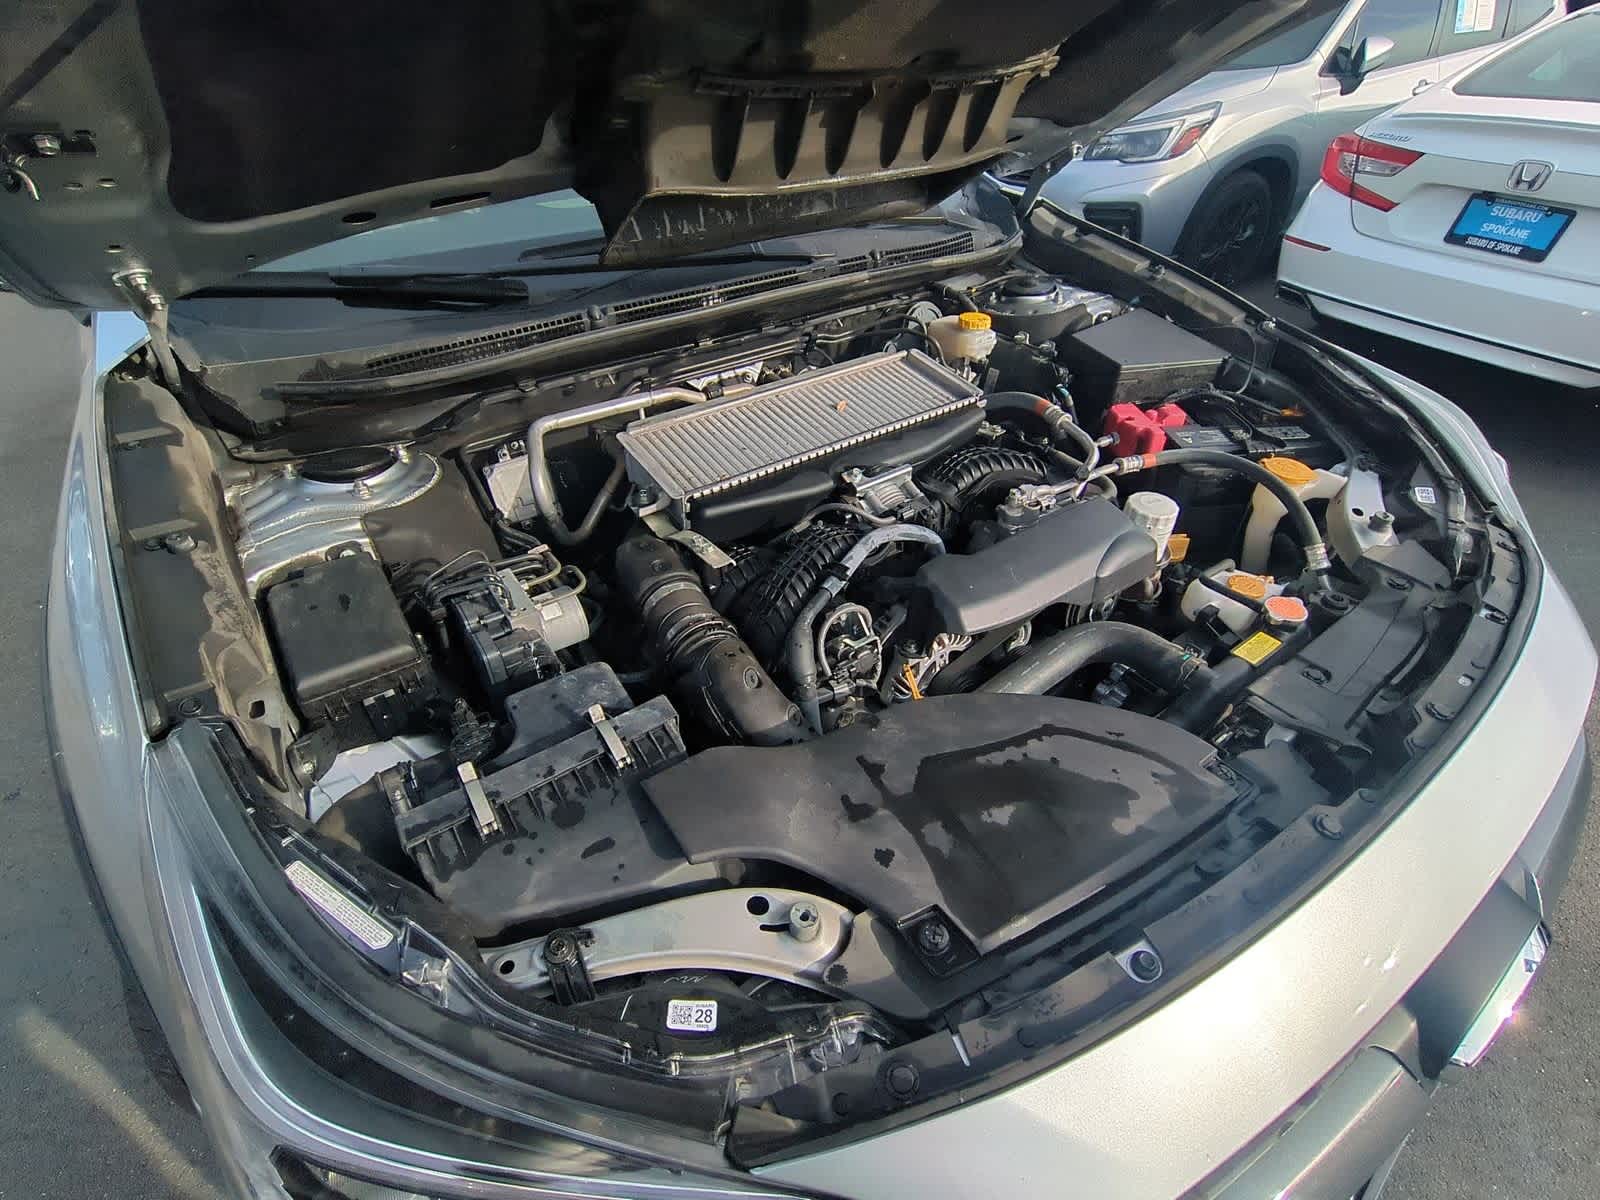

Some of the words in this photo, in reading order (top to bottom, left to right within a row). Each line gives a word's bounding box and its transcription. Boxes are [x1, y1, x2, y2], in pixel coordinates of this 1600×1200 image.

[1490, 206, 1542, 222] SUBARU
[1481, 223, 1531, 239] SPOKANE
[1465, 236, 1487, 248] SUBARU
[1495, 243, 1523, 255] SPOKANE
[695, 1008, 712, 1023] 28
